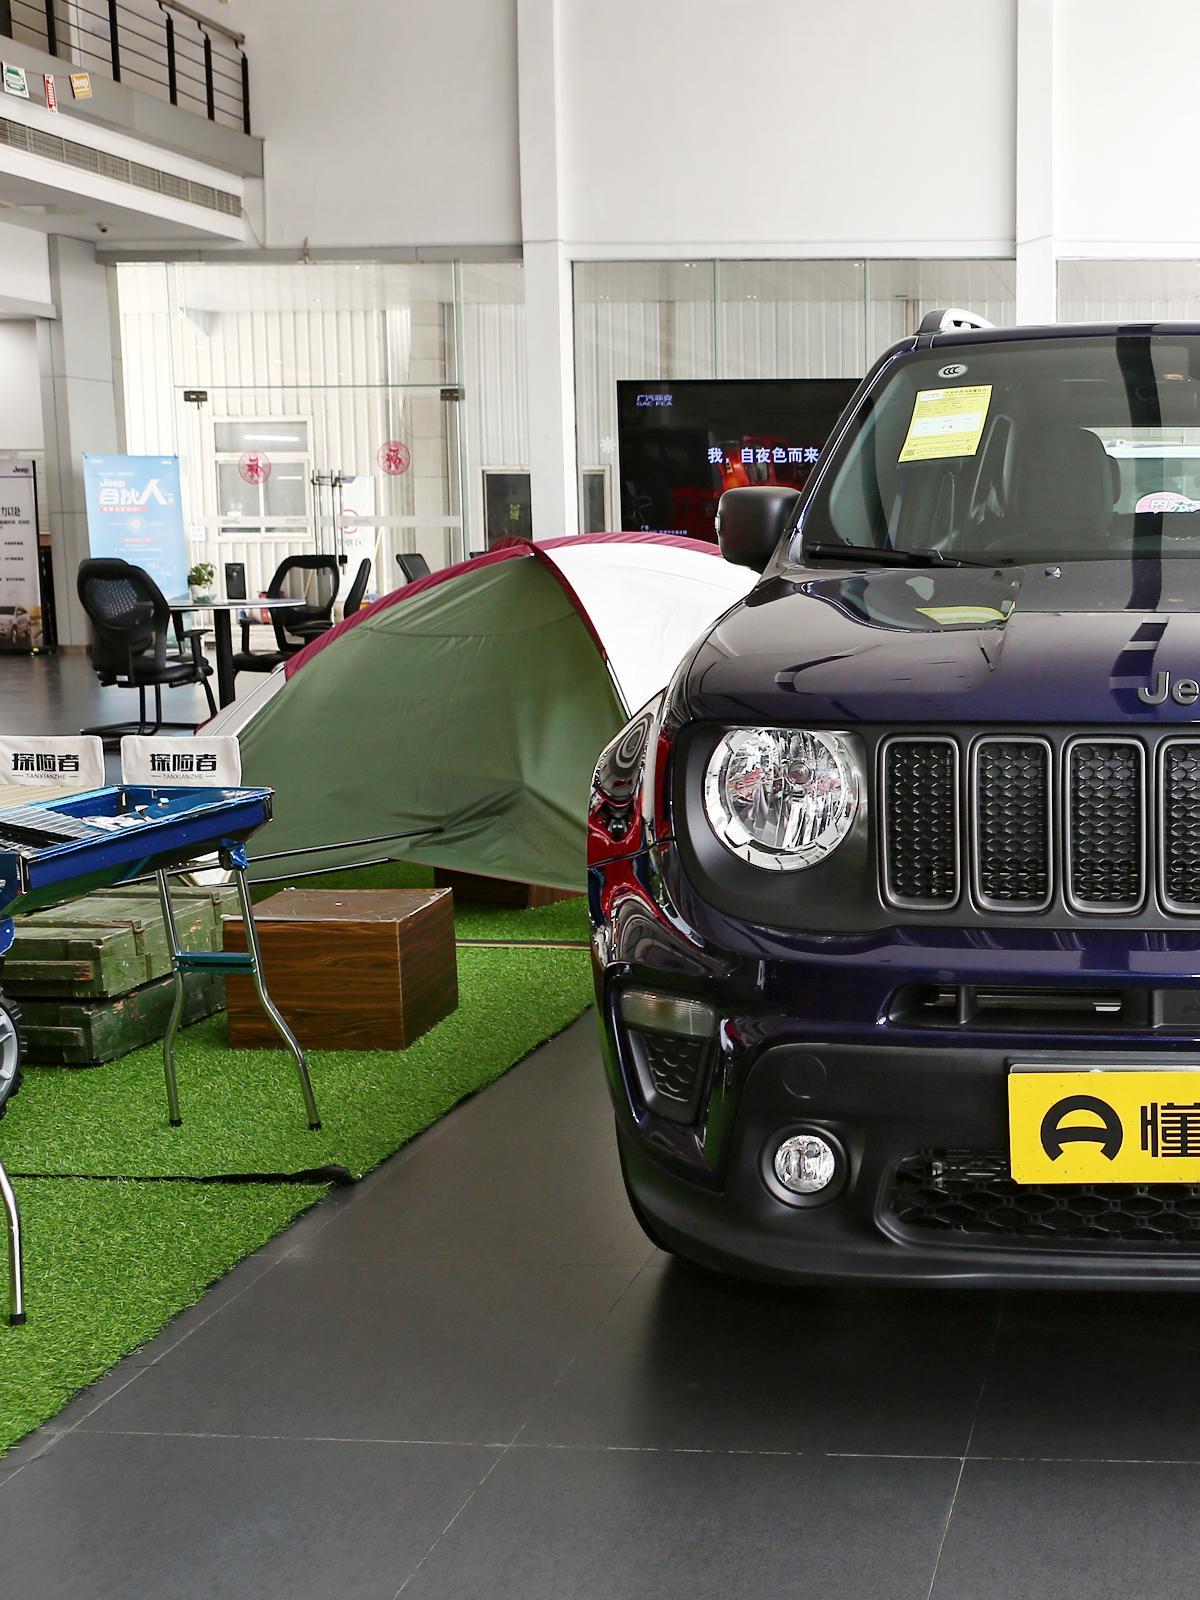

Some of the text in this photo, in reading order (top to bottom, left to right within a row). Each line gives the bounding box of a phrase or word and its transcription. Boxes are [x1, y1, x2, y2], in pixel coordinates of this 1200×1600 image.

[12, 466, 29, 474] Jeep
[100, 479, 126, 488] Jeep
[12, 753, 80, 772] 探险者
[150, 754, 217, 772] 探险者
[26, 773, 67, 781] TANXIANZHE
[163, 773, 204, 781] TANXIANZHE
